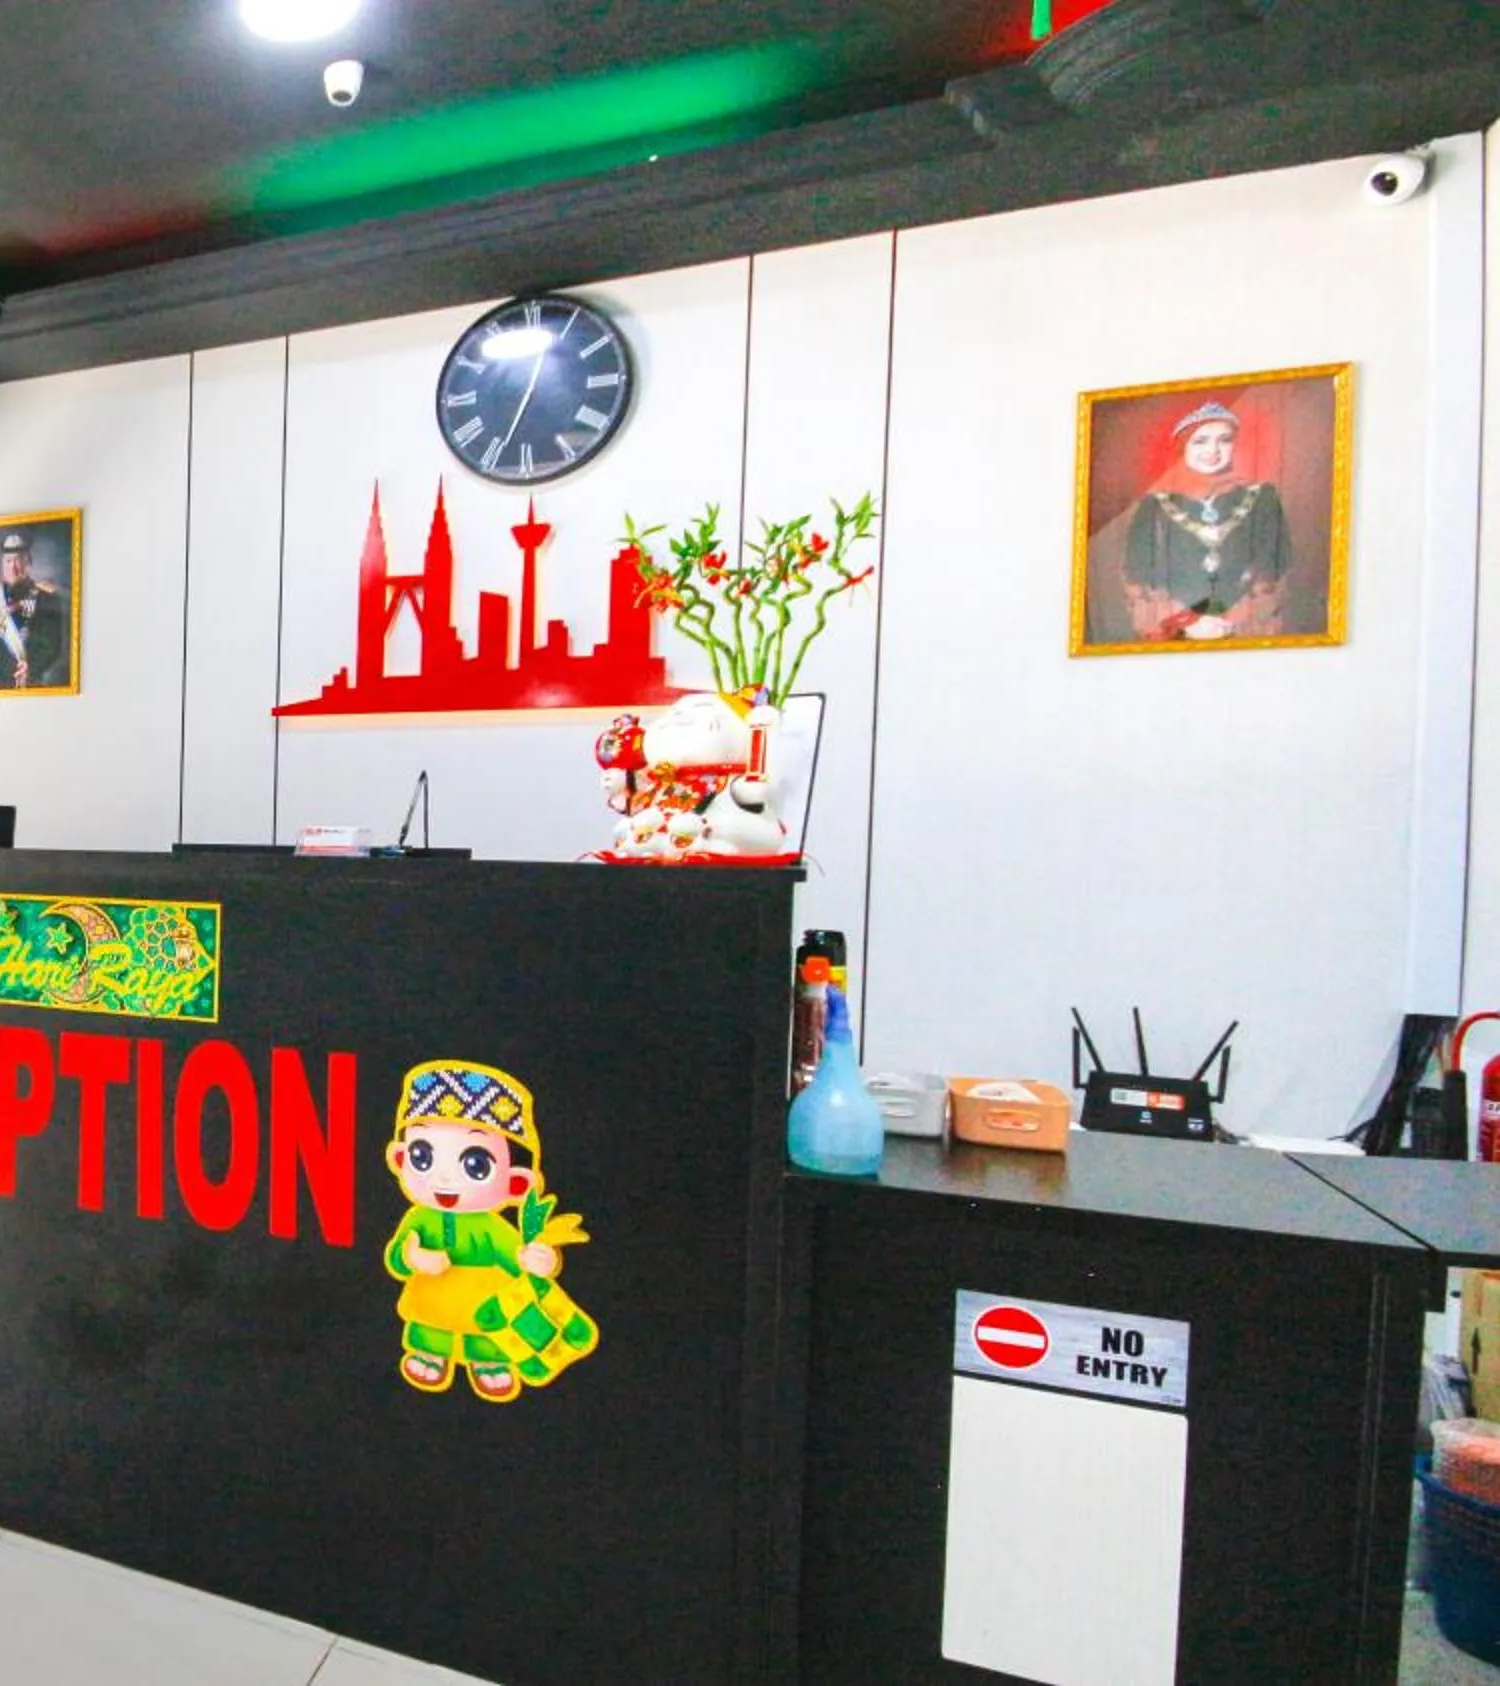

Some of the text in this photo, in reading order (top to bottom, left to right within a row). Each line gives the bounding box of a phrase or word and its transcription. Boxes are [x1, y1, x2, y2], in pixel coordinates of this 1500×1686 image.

[87, 943, 204, 1015] Raya
[1101, 1326, 1144, 1357] NO
[1076, 1355, 1168, 1388] ENTRY
